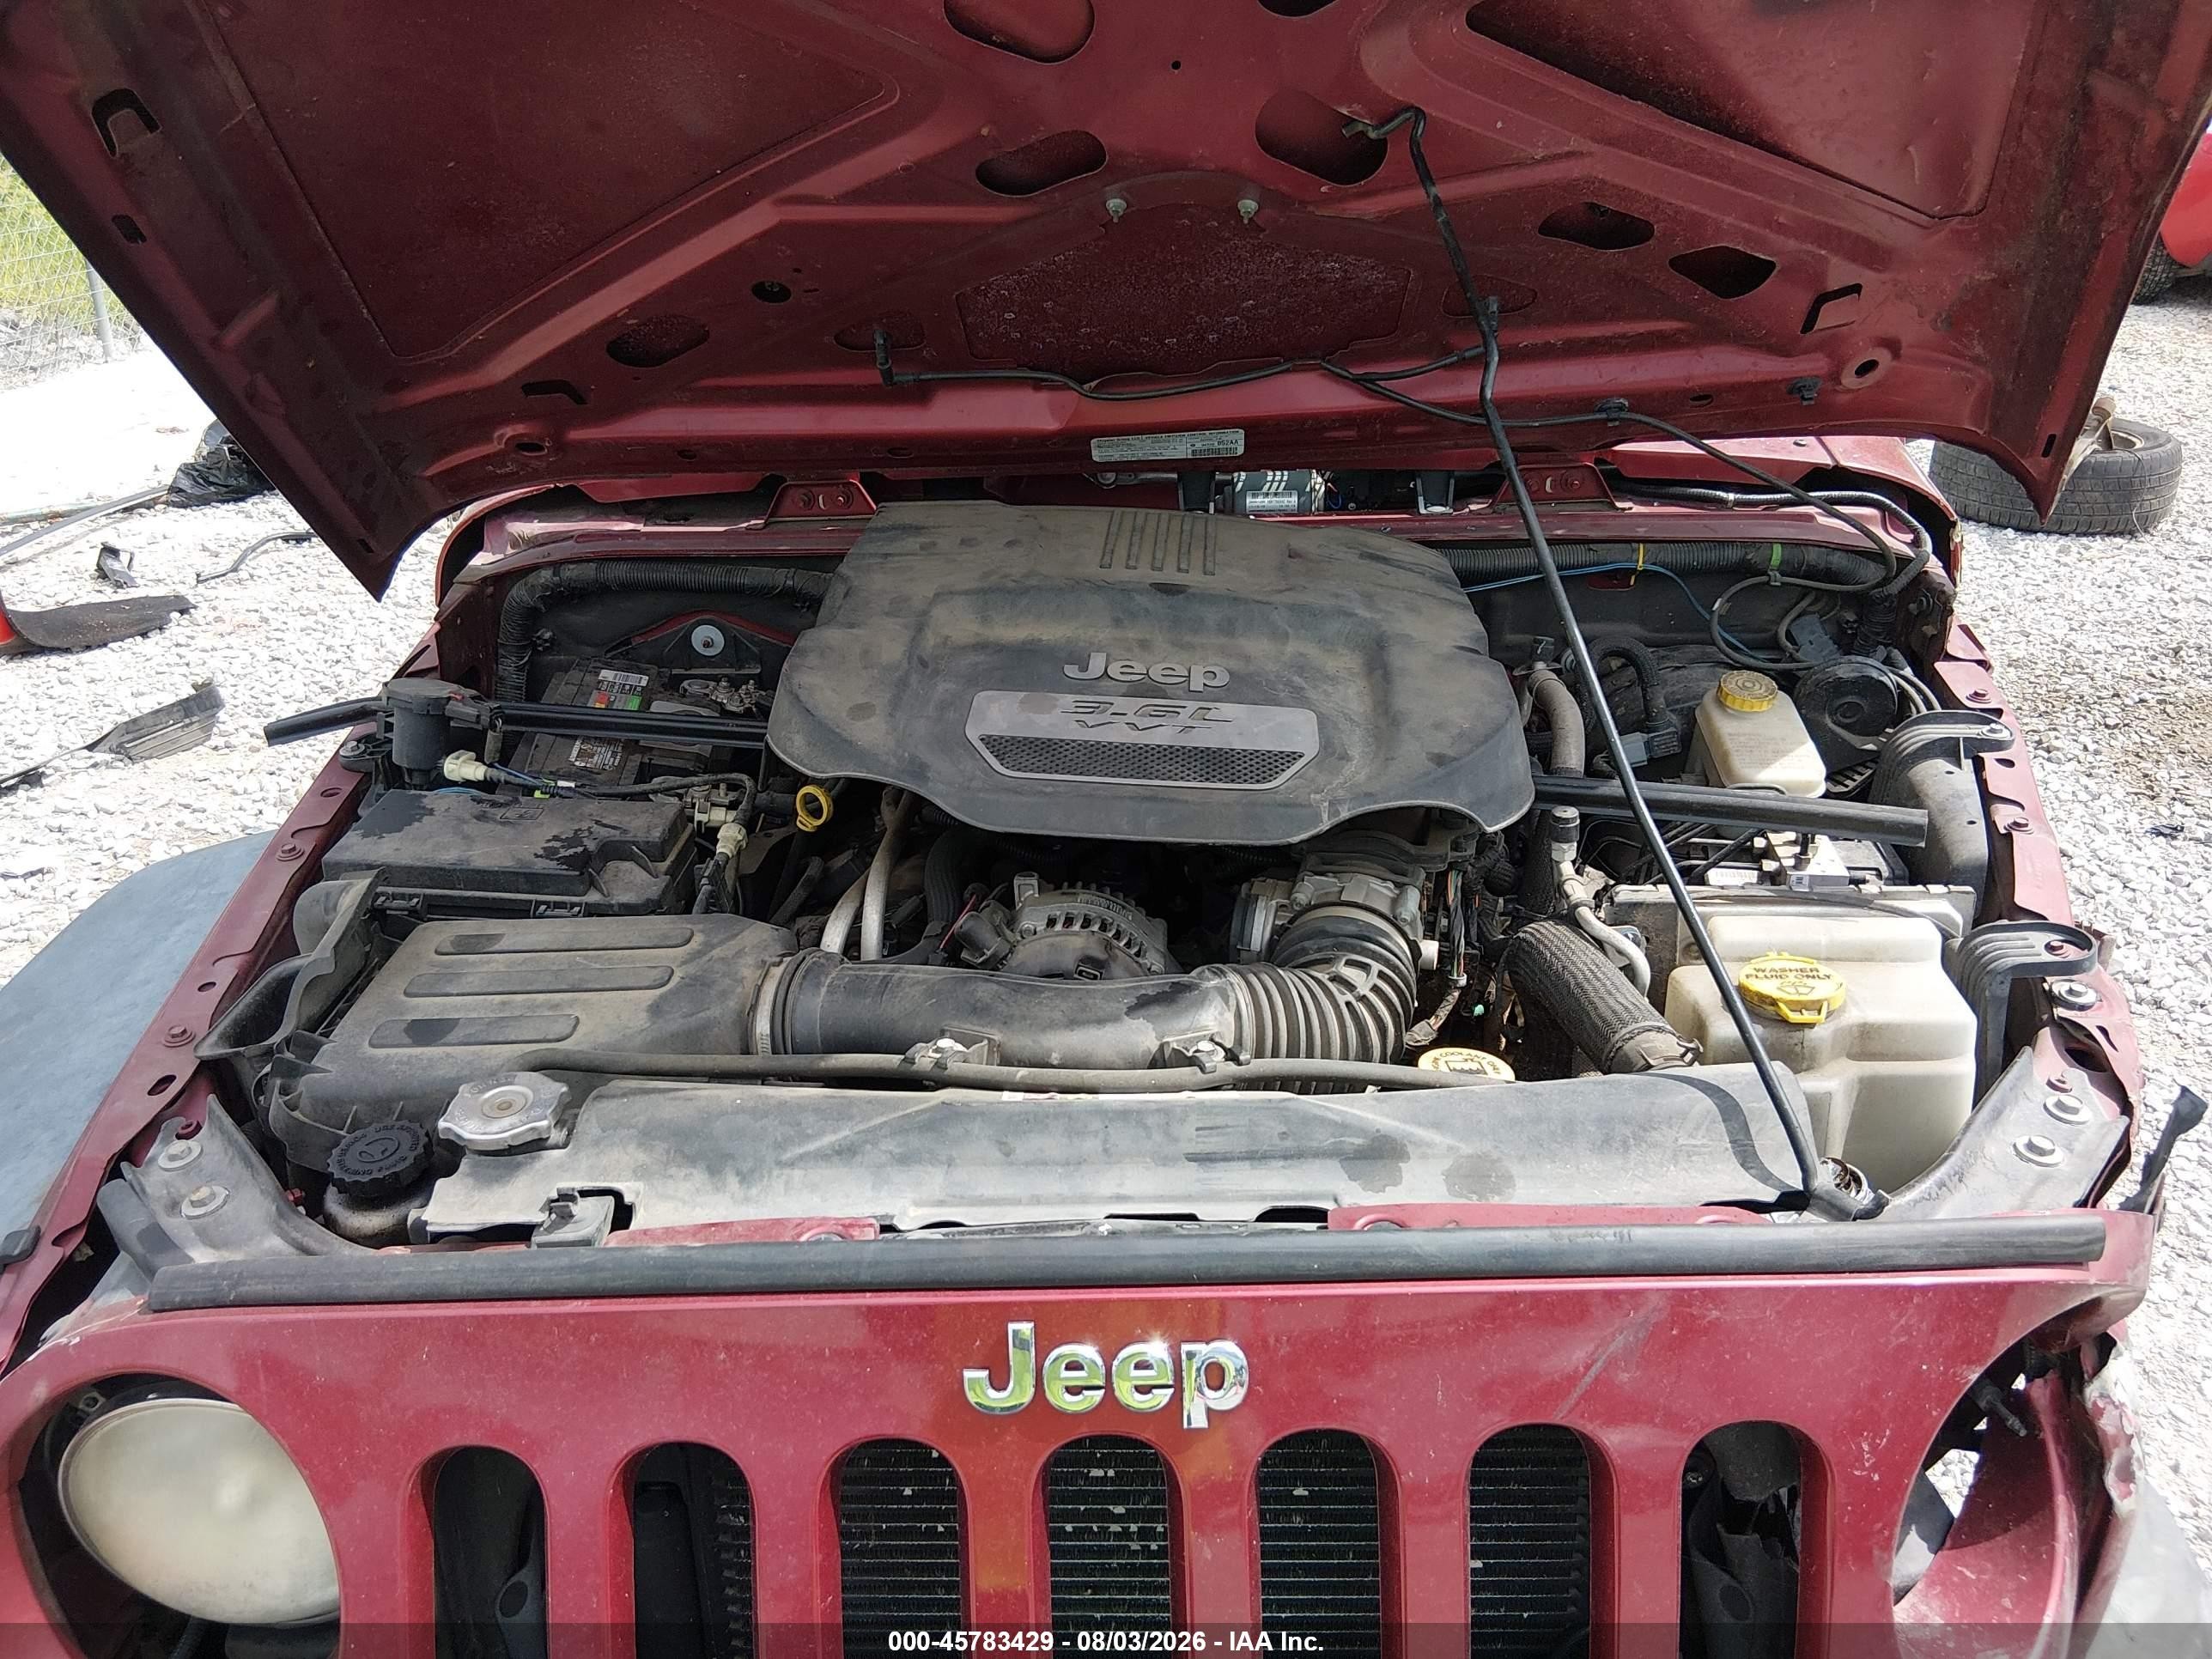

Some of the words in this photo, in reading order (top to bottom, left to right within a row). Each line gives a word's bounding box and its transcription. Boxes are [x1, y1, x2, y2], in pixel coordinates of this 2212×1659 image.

[1062, 652, 1231, 693] Jeep
[1060, 700, 1235, 723] 3.6L
[1073, 719, 1212, 734] VVT
[1439, 1051, 1487, 1060] COOLANT
[963, 1321, 1249, 1429] Jeep
